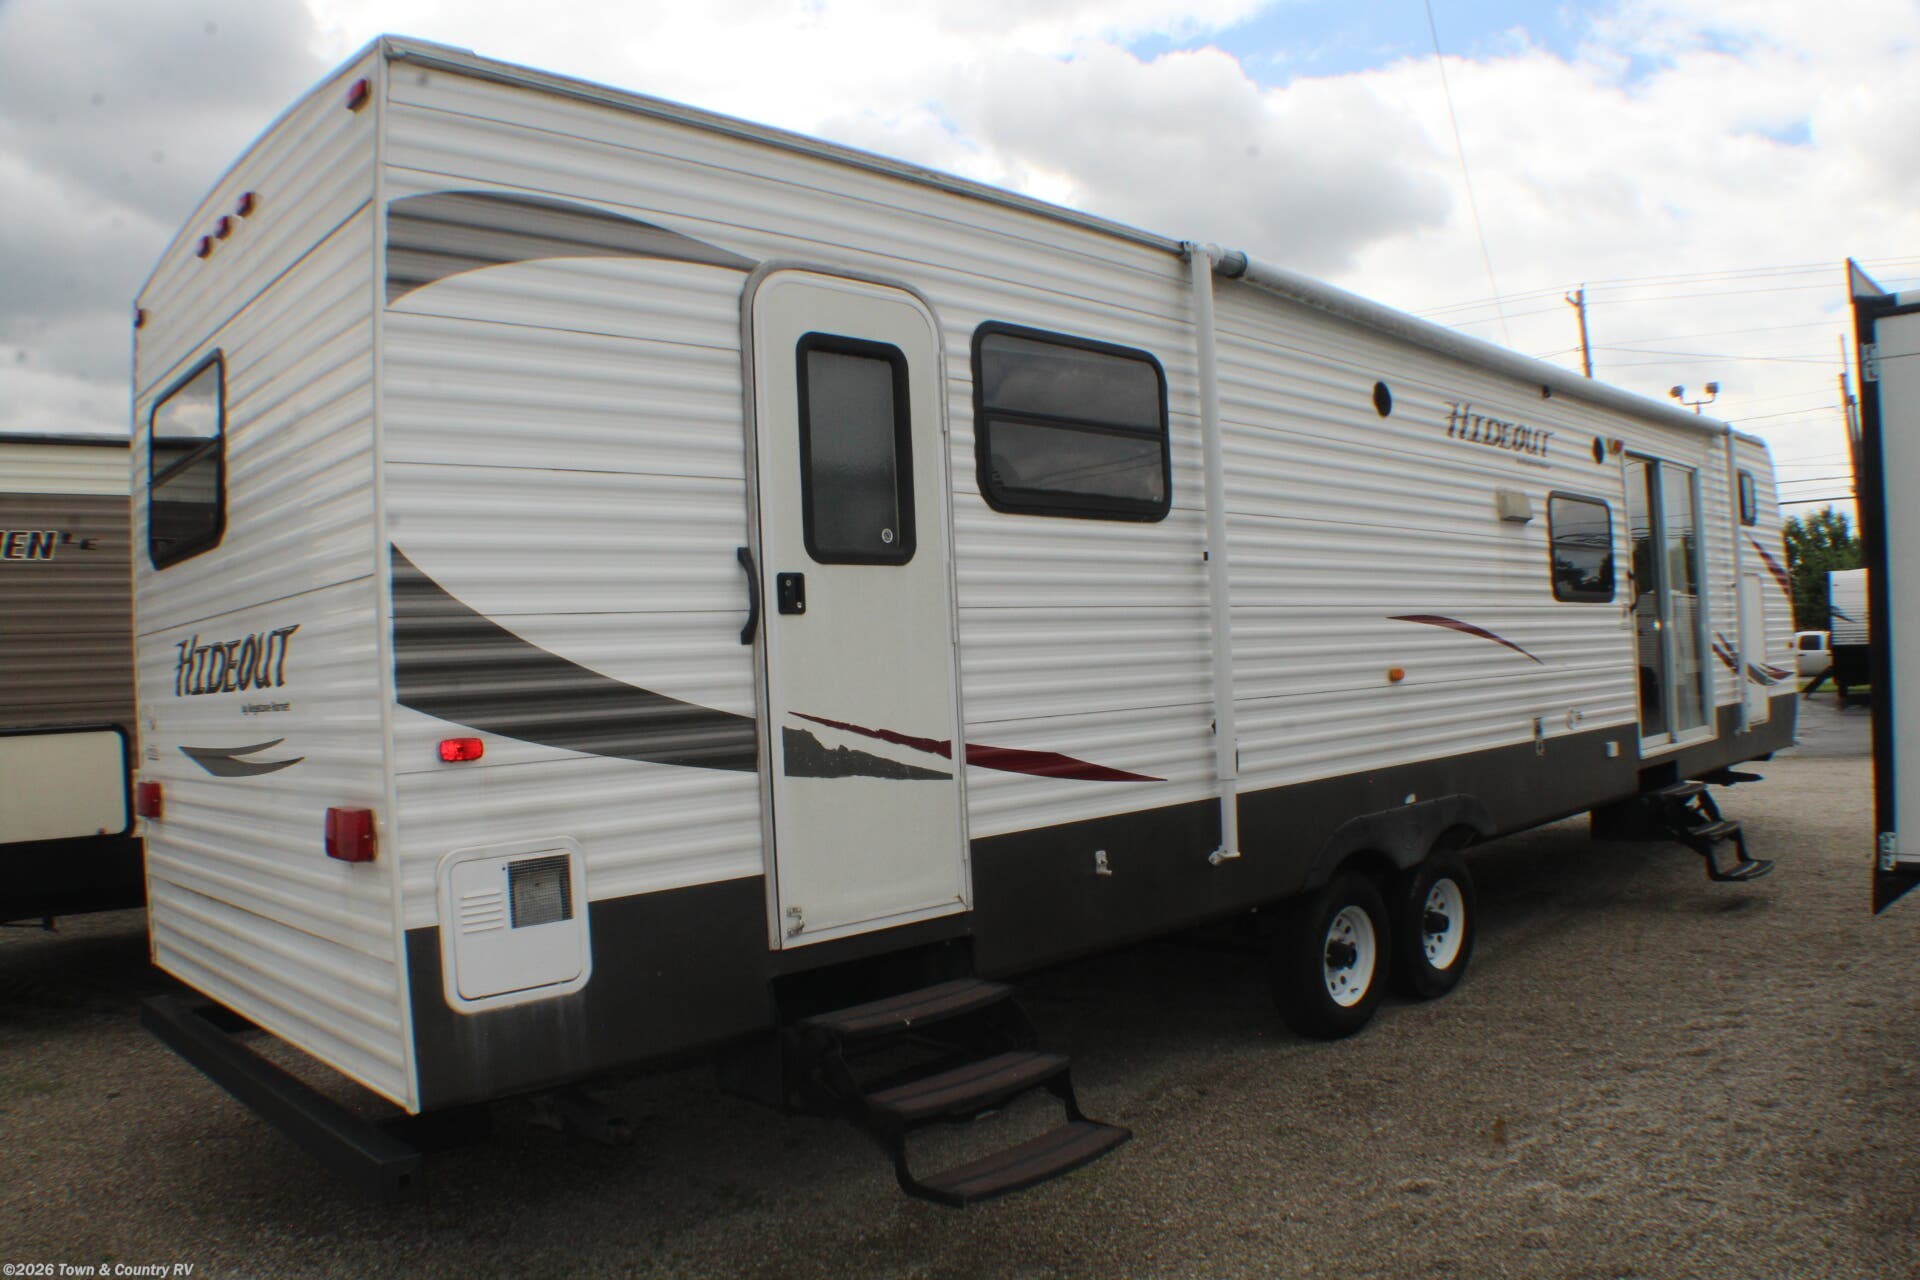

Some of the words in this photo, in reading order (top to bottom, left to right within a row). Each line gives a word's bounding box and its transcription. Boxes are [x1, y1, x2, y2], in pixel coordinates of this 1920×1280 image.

[1445, 401, 1554, 458] HIDEOUT
[0, 530, 58, 561] EN
[174, 624, 301, 697] HIDEOUT
